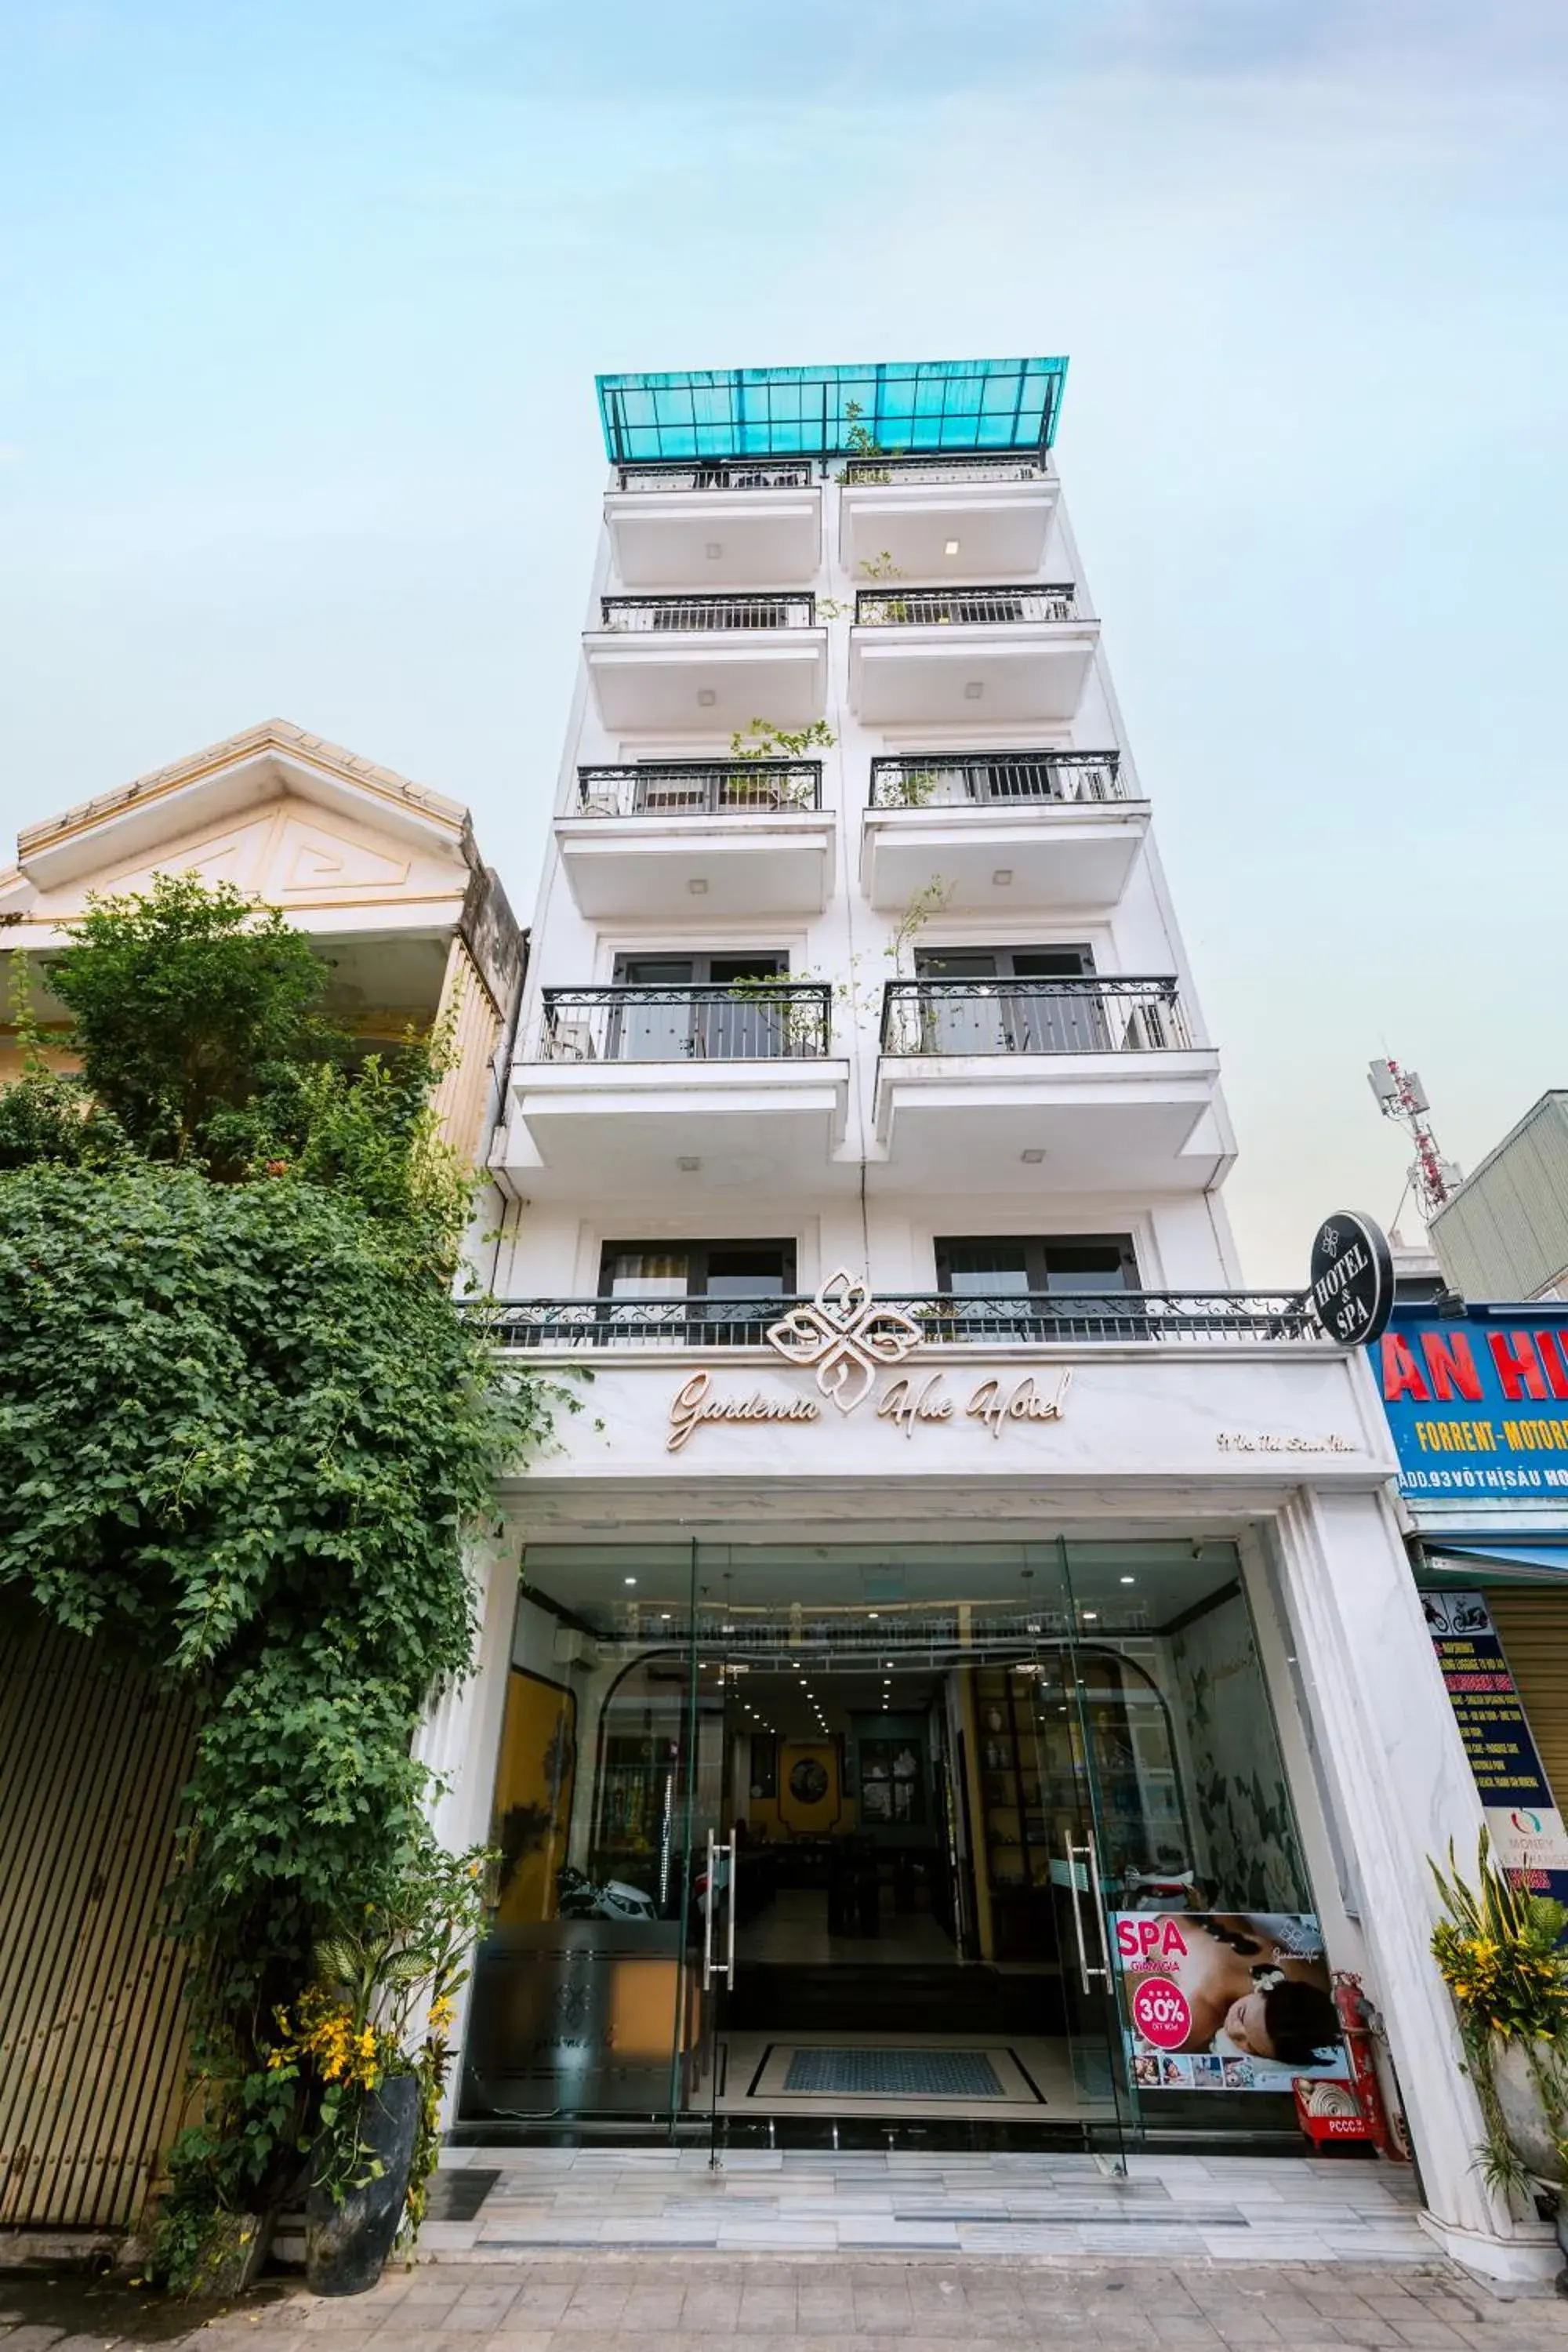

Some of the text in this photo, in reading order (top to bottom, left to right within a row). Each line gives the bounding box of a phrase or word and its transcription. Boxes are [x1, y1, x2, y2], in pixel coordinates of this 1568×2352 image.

[1315, 1243, 1369, 1307] HOTEL
[1341, 1288, 1352, 1304] &
[1337, 1296, 1370, 1339] SPA
[1380, 1330, 1484, 1401] AN
[666, 1369, 821, 1450] Gardenia
[966, 1367, 1073, 1439] Hotel
[1116, 1920, 1189, 1956] SPA
[1139, 1998, 1185, 2022] 30%
[1329, 2119, 1356, 2132] PCCC
